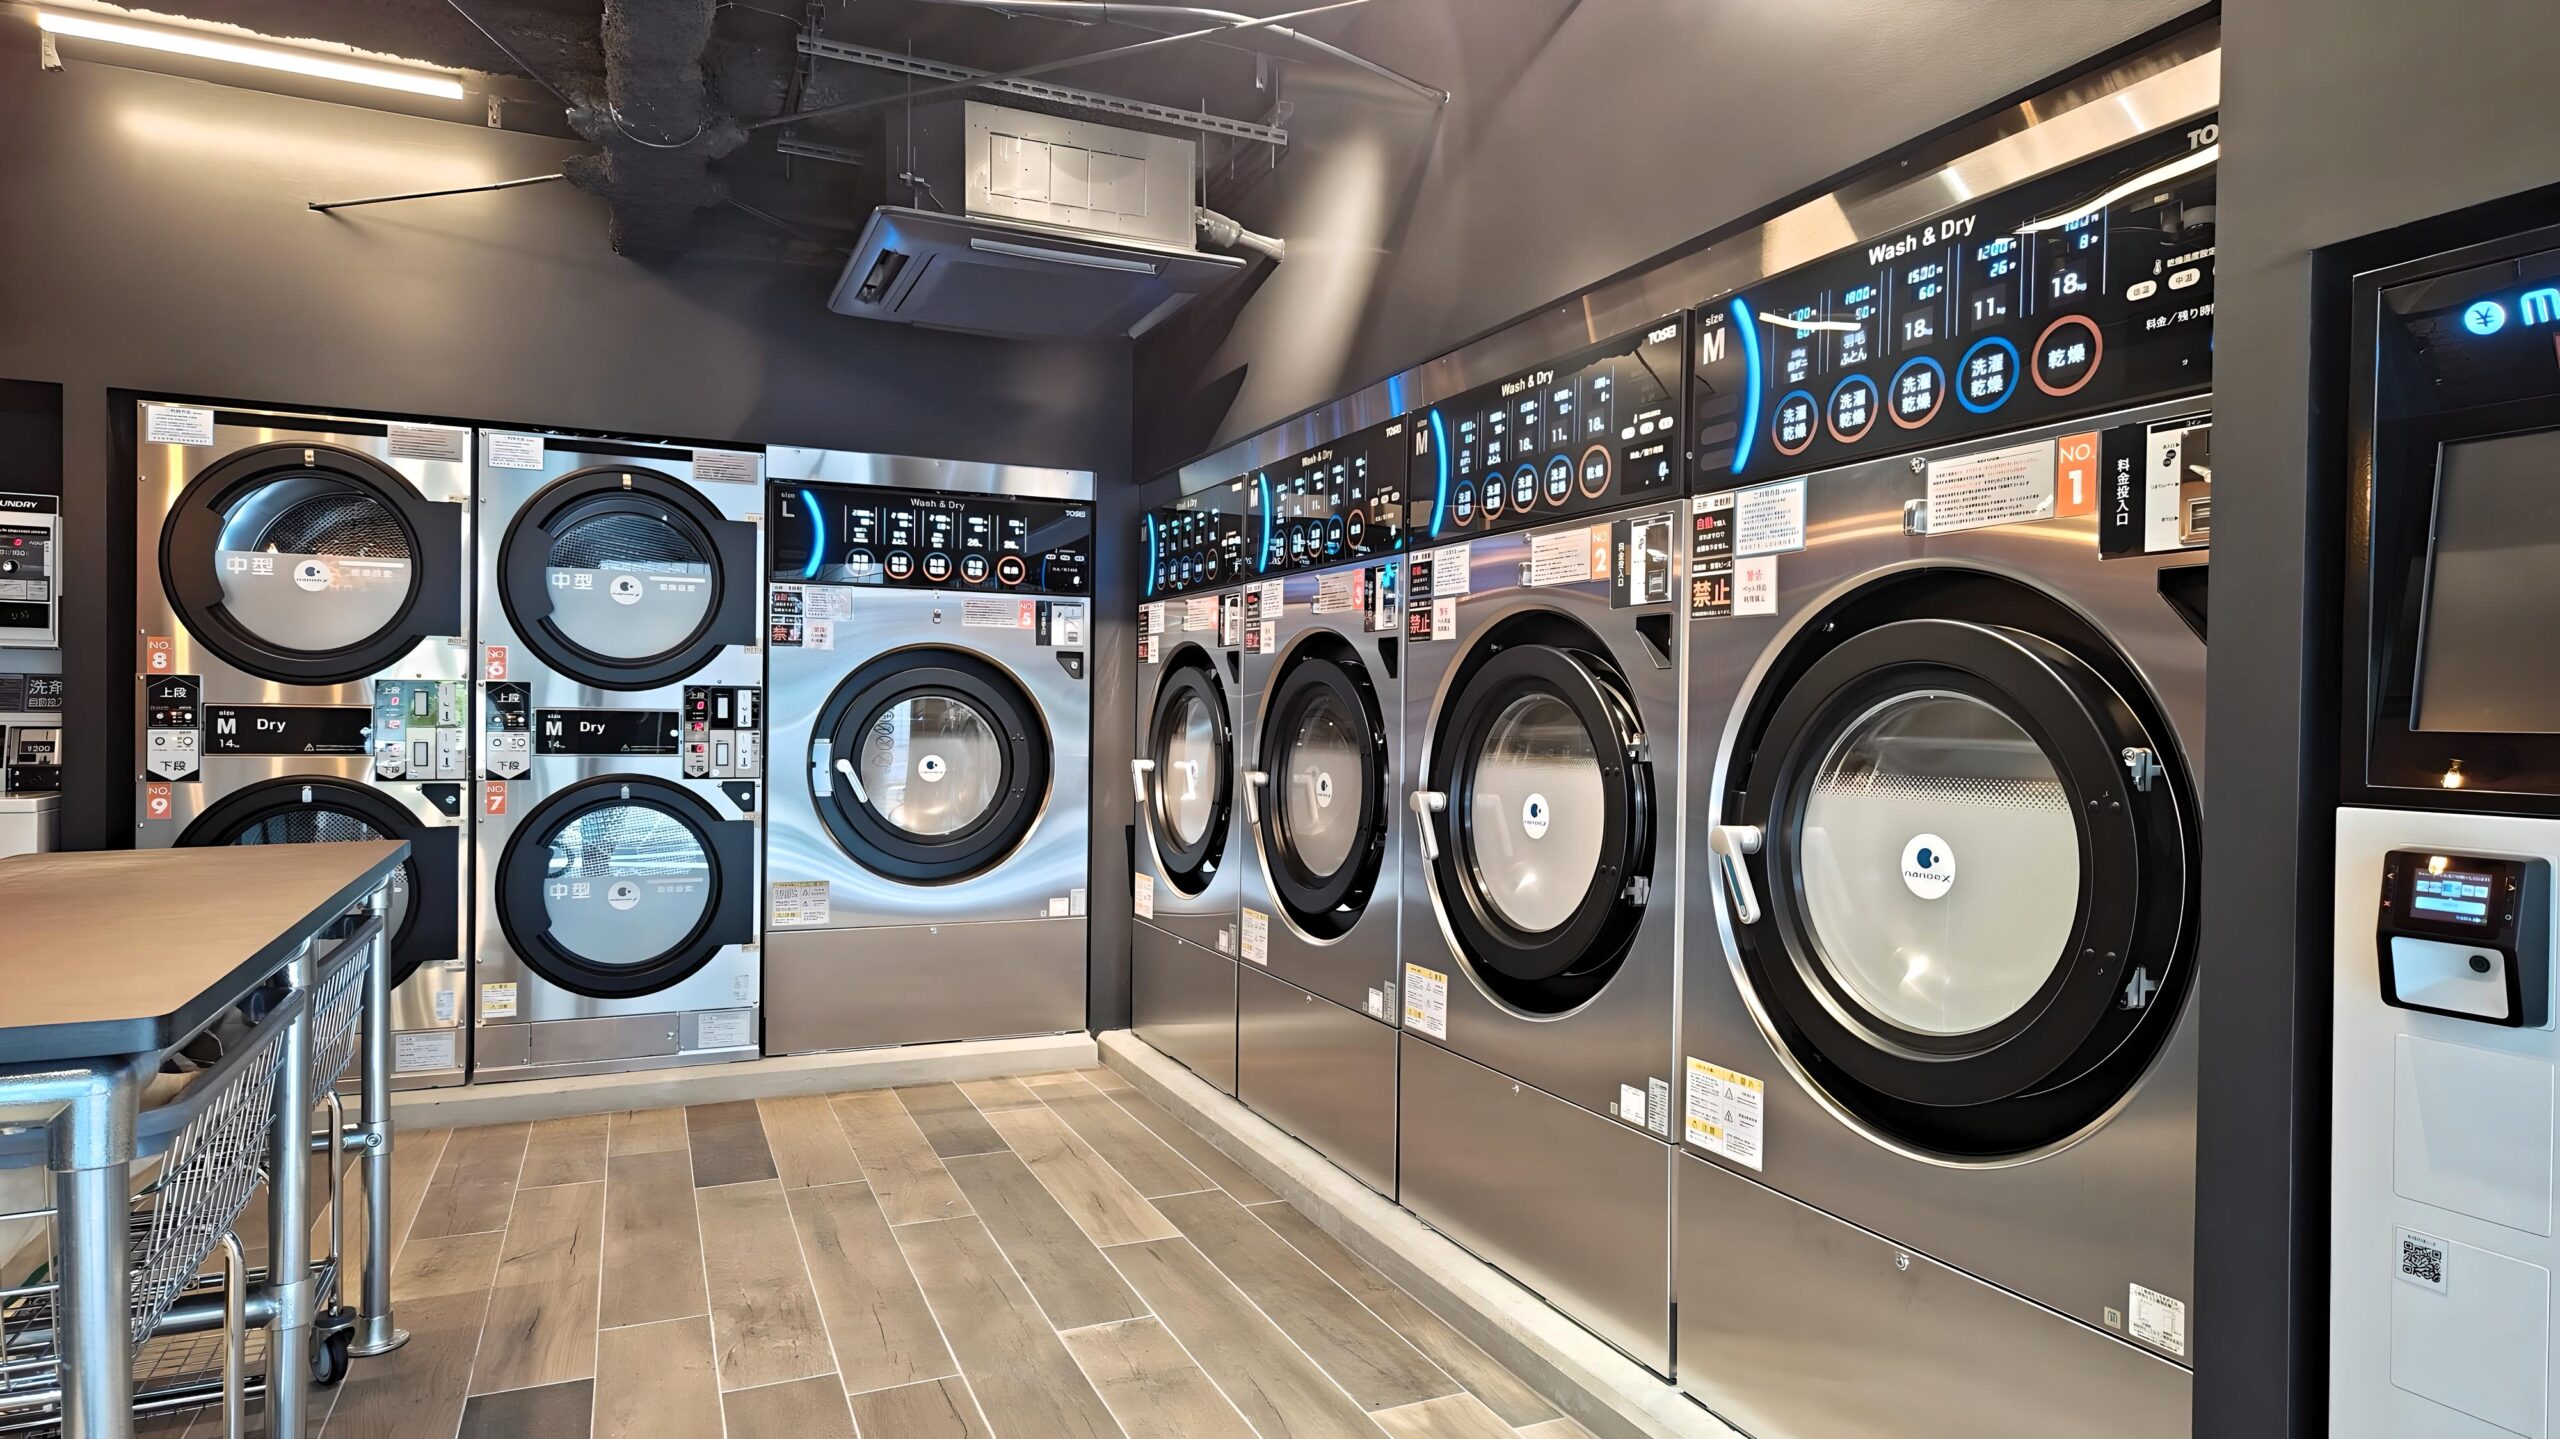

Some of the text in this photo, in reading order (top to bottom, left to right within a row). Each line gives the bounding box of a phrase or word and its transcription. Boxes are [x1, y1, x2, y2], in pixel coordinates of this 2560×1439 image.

[1868, 214, 1977, 266] Wash & Dry
[1705, 312, 1724, 327] size
[1702, 327, 1726, 366] M
[2047, 343, 2086, 370] 乾燥
[1970, 352, 2004, 378] 洗濯
[1501, 369, 1554, 397] Wash & Dry
[1902, 371, 1932, 395] 洗濯
[1970, 374, 2004, 398] 乾燥
[1839, 388, 1867, 410] 洗濯
[1901, 391, 1932, 414] 乾燥
[1838, 407, 1866, 429] 乾燥
[1415, 429, 1428, 456] M
[2060, 443, 2096, 464] NO.
[2068, 469, 2083, 505] 1
[2116, 457, 2130, 527] 料金投入口
[781, 500, 796, 518] L
[910, 497, 966, 511] Wash & Dry
[1594, 547, 1607, 573] 2
[1692, 578, 1731, 608] 禁止
[1022, 612, 1031, 626] 5
[1409, 613, 1431, 634] 禁止
[152, 652, 168, 669] 8
[487, 660, 504, 676] 6
[159, 687, 187, 698] 上段
[497, 692, 521, 703] 上段
[217, 718, 236, 735] M
[256, 718, 287, 734] Dry
[545, 721, 563, 736] M
[579, 721, 606, 735] Dry
[160, 760, 187, 771] 下段
[497, 760, 520, 771] 下段
[151, 797, 168, 814] 9
[489, 795, 504, 811] 7
